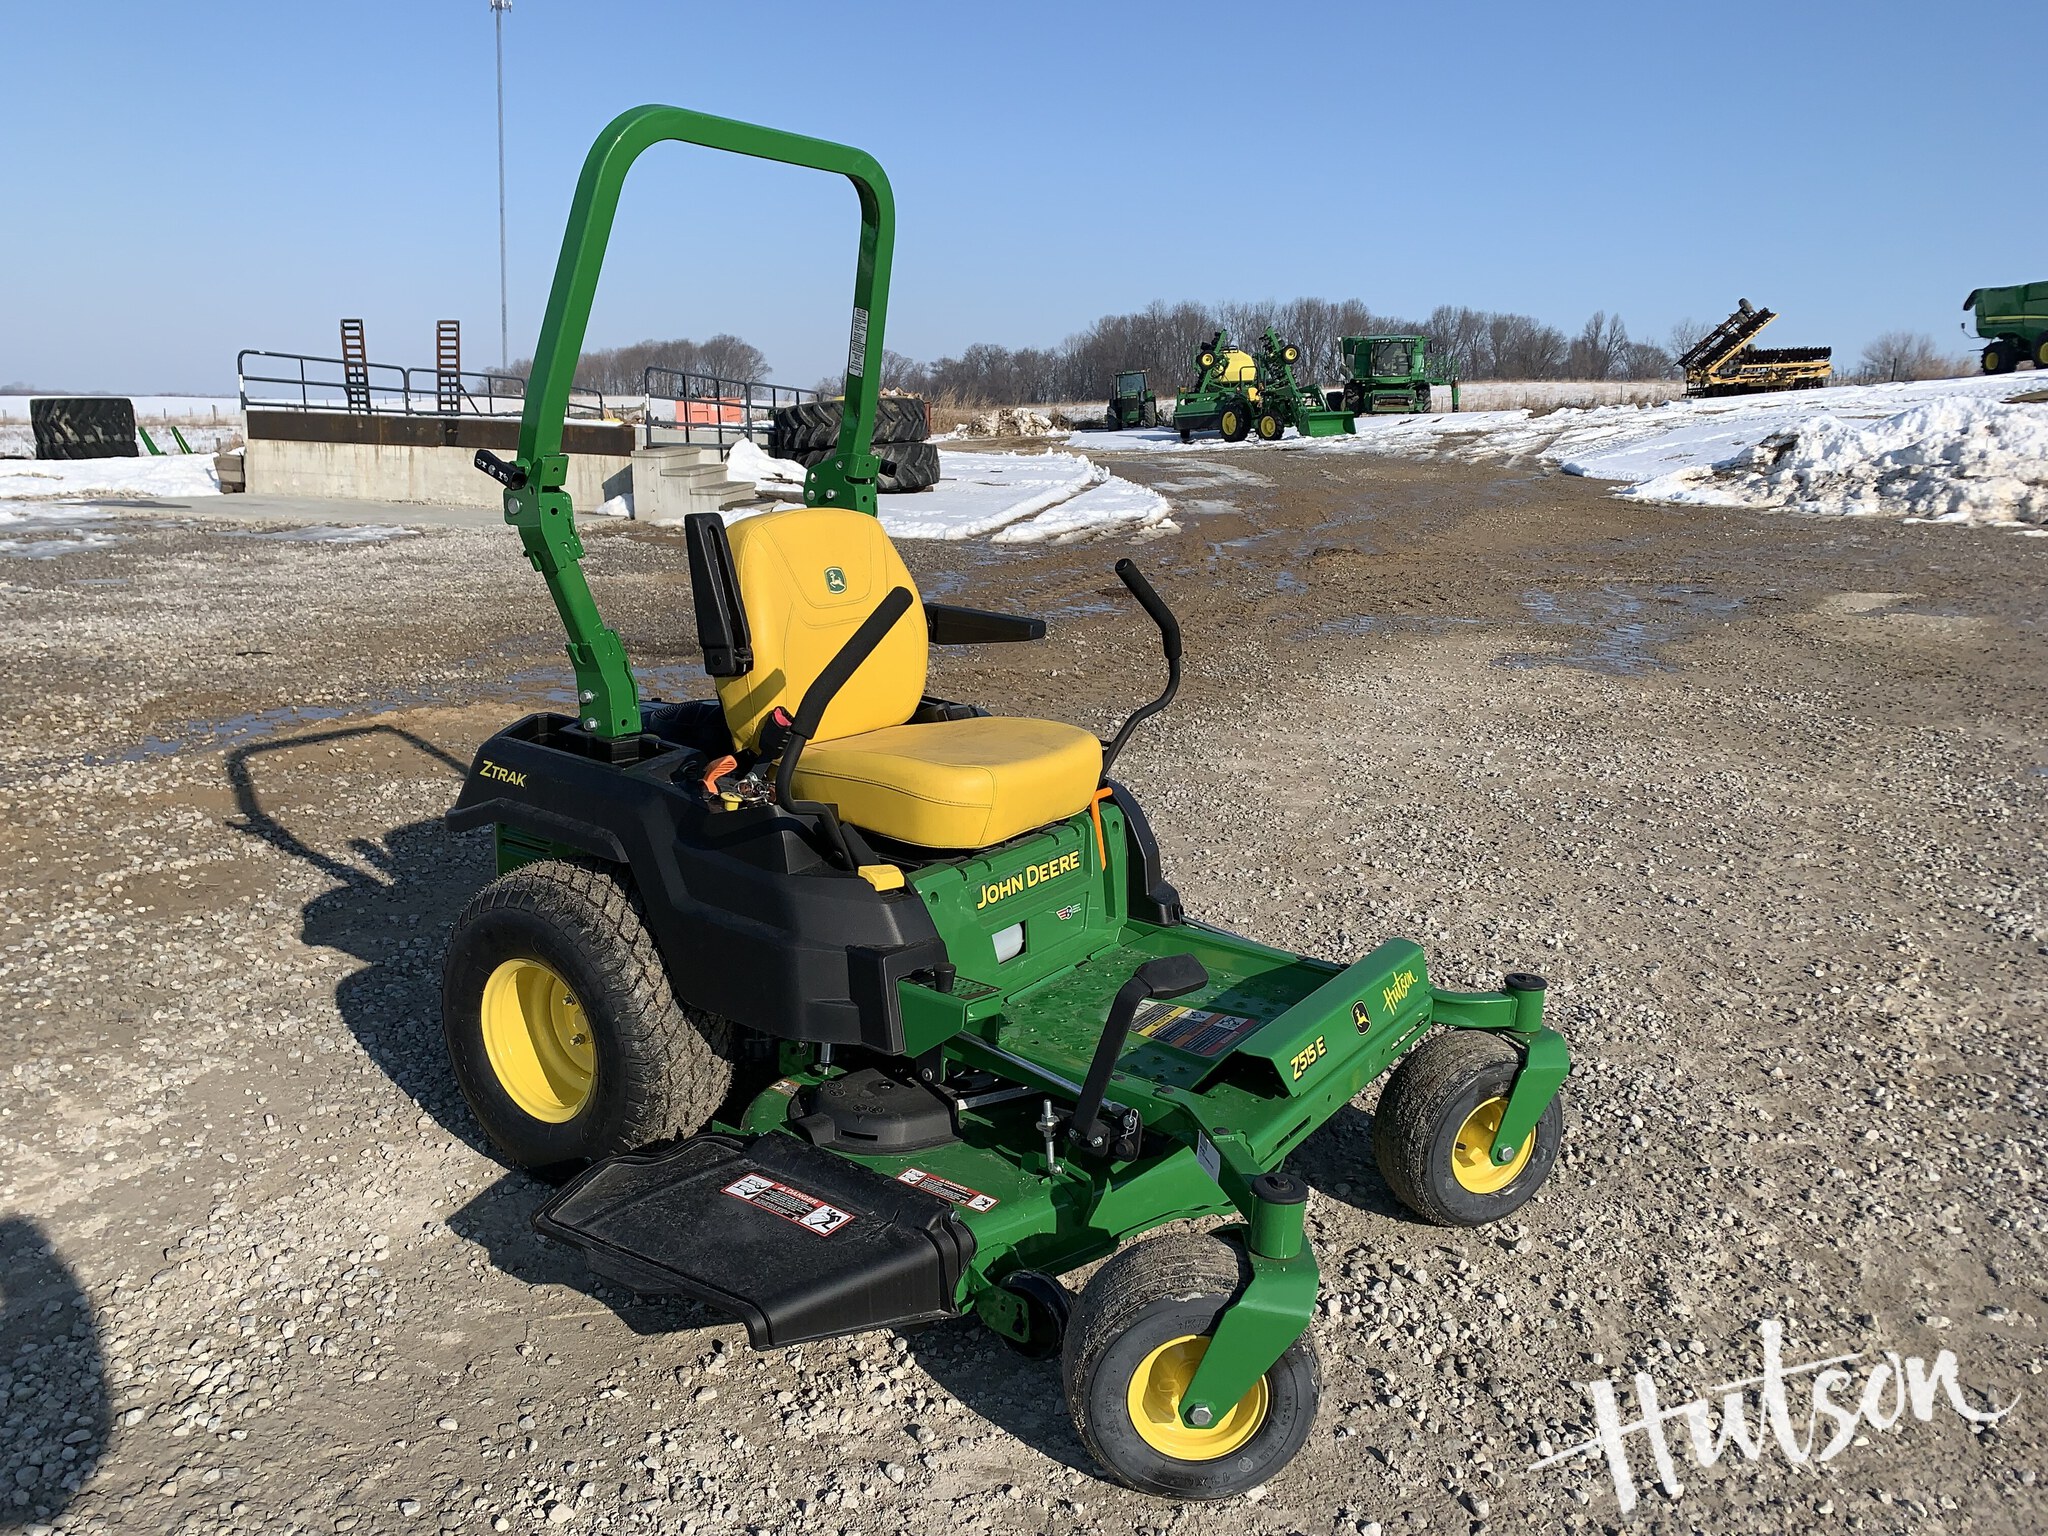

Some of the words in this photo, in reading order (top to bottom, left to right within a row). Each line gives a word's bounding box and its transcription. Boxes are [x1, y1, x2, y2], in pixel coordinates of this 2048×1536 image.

[480, 760, 527, 787] ZTRAK
[977, 873, 1023, 909] JOHN
[1026, 850, 1080, 888] DEERE
[1383, 970, 1418, 1016] Hutson
[1290, 1043, 1317, 1080] Z515
[1316, 1035, 1327, 1058] E
[786, 1188, 819, 1205] DANGER
